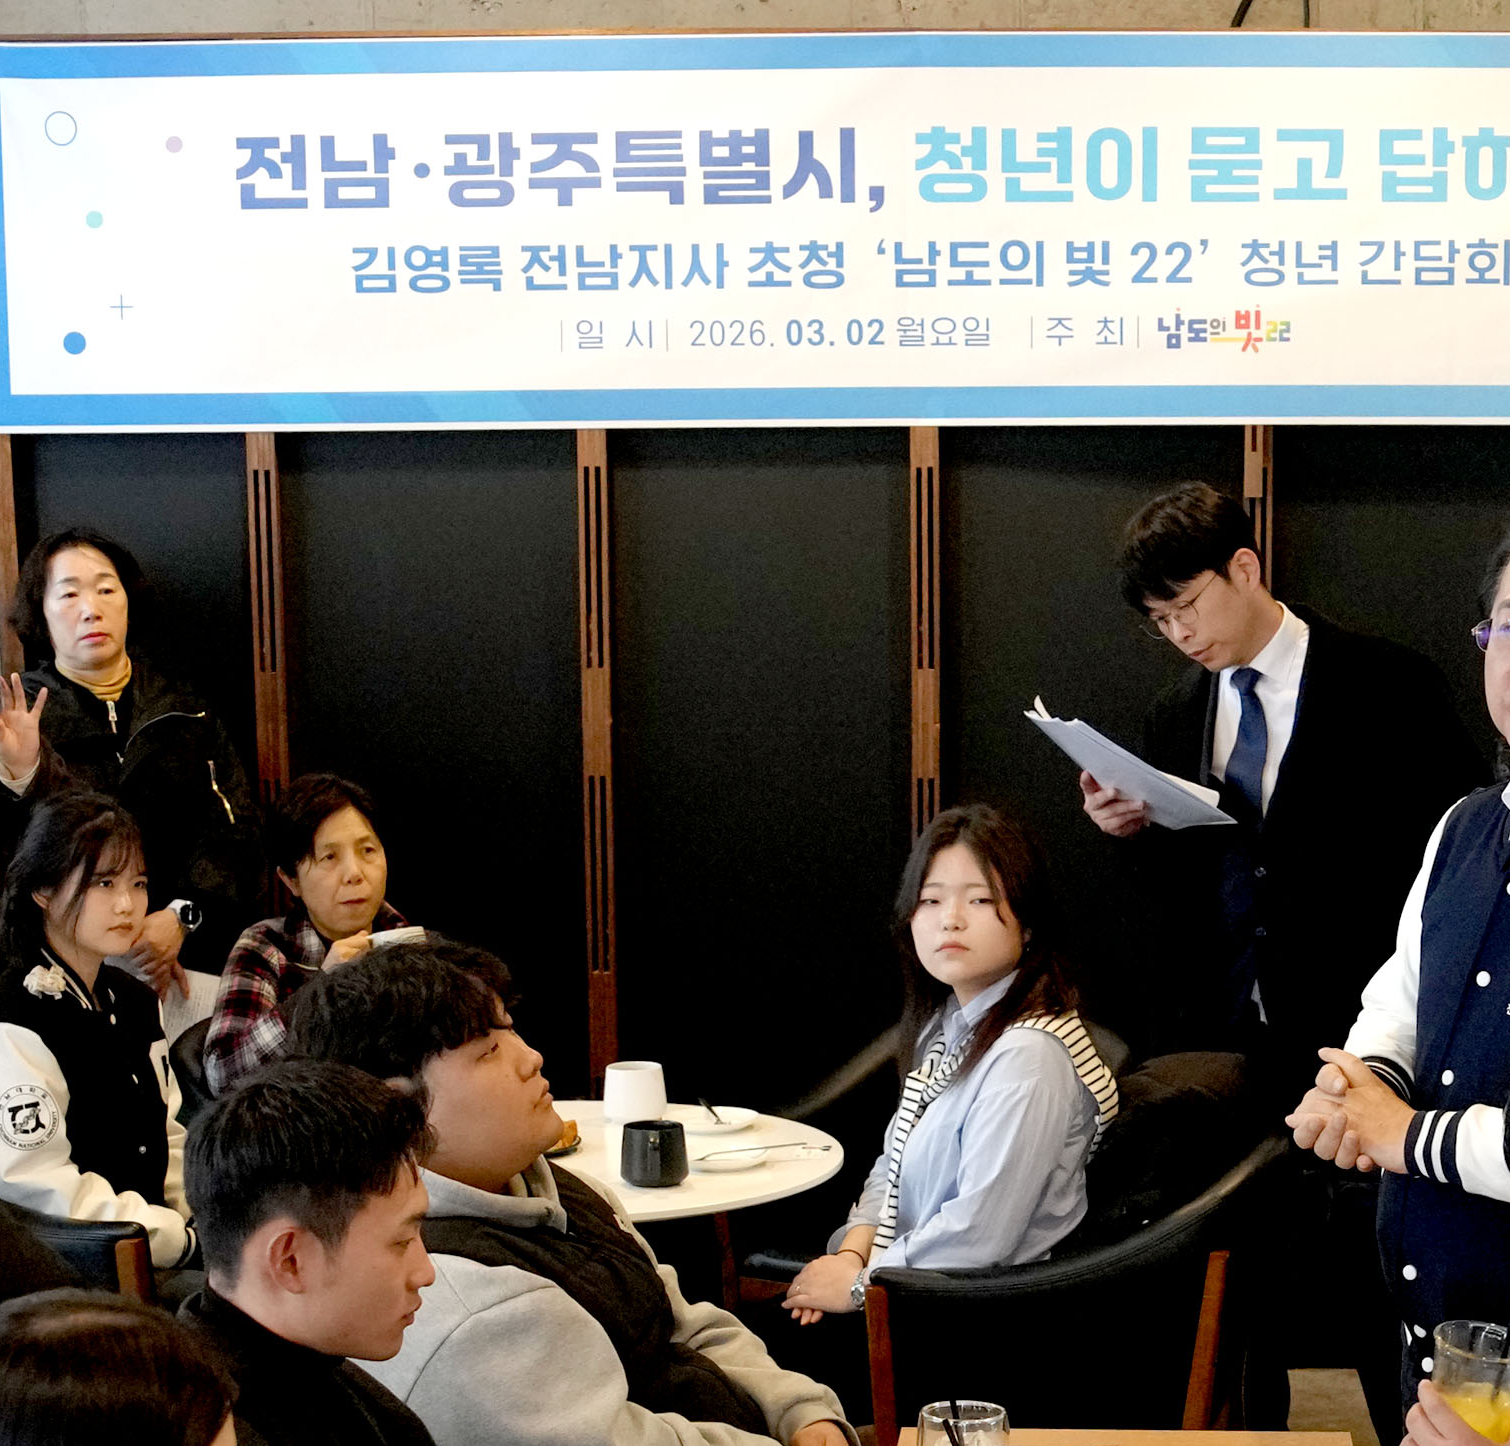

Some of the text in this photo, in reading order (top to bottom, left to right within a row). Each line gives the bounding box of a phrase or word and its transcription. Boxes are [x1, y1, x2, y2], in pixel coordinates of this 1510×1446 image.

[234, 126, 887, 214] 전남·광주특별시,
[913, 124, 1159, 204] 청년이
[1187, 126, 1349, 203] 묻고
[350, 244, 505, 295] 김영록
[519, 241, 731, 293] 전남지사
[746, 238, 847, 291] 초청
[876, 237, 1045, 288] ‘남도의
[1064, 239, 1113, 288] 빛
[1238, 237, 1340, 288] 청년
[895, 315, 992, 348] 월요일
